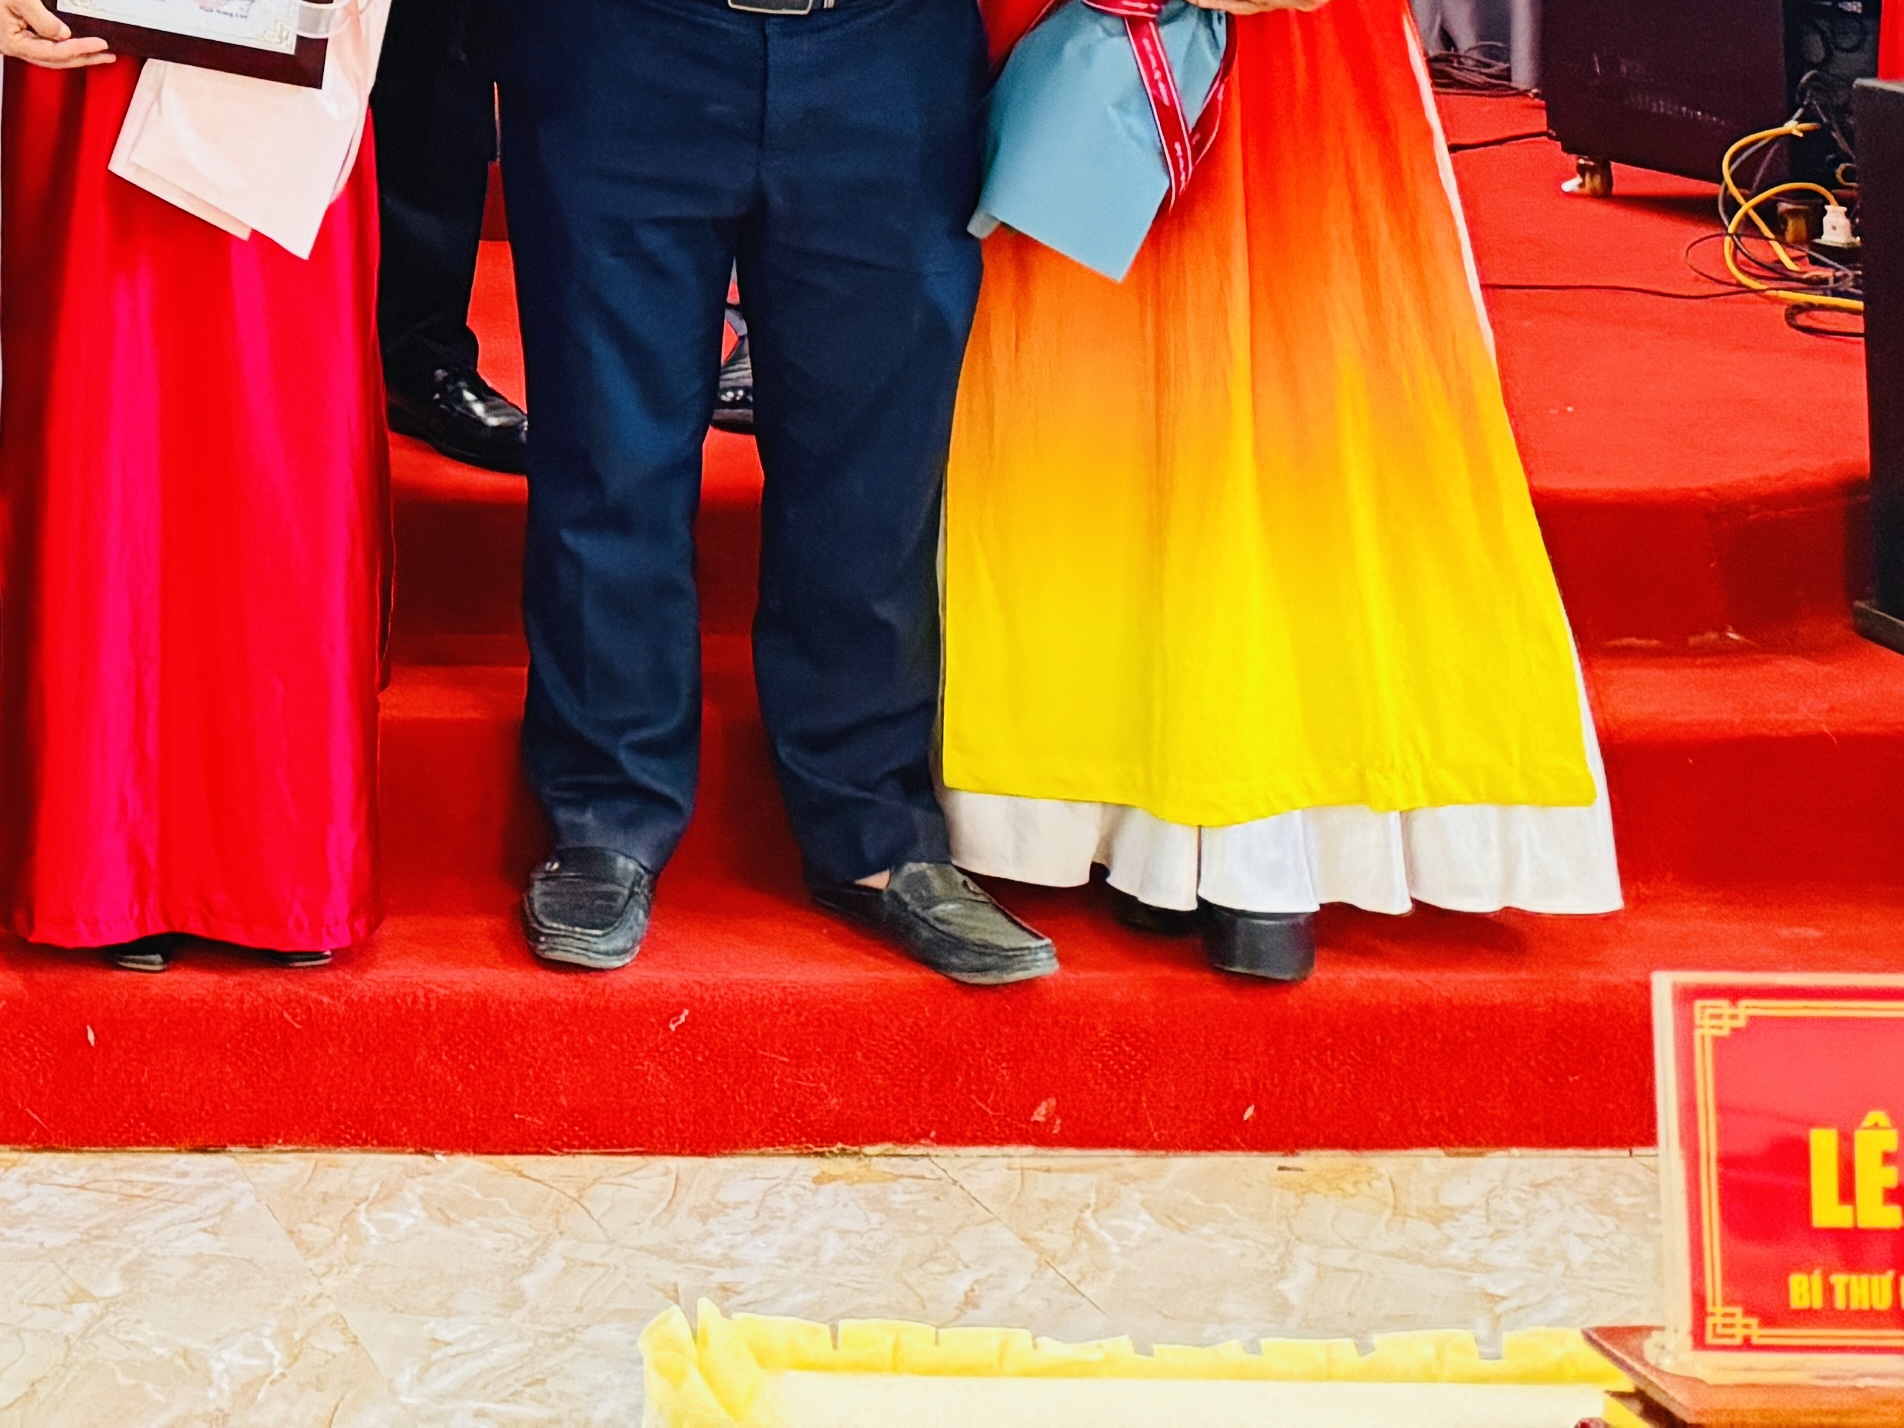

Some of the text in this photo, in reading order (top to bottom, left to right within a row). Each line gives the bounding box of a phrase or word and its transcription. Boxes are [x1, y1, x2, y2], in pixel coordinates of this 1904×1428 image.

[1809, 1111, 1903, 1229] LÊ
[1789, 1269, 1823, 1311] BÍ
[1830, 1270, 1896, 1312] THƯ
